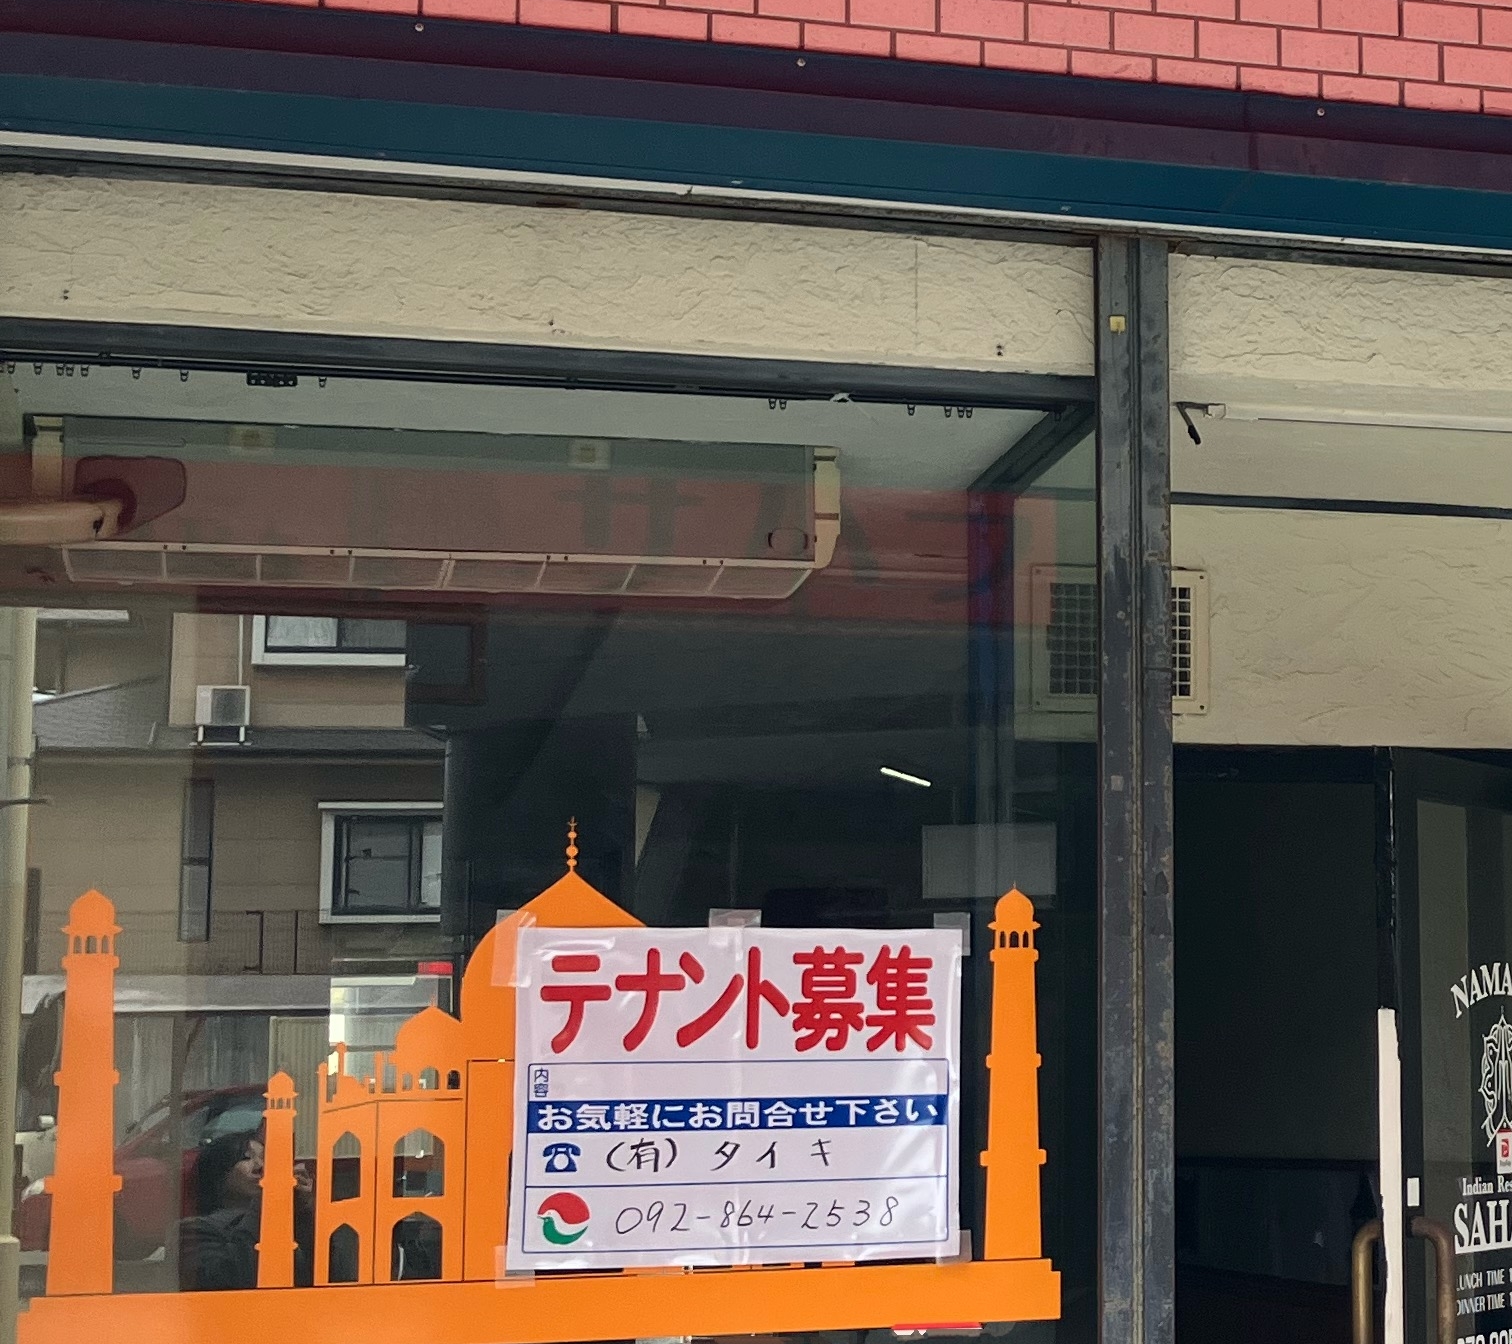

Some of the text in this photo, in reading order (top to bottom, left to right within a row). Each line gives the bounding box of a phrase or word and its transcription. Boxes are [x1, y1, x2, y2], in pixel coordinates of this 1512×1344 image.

[540, 944, 936, 1054] テナント募集
[533, 1067, 550, 1099] 内容
[537, 1097, 939, 1132] お気軽にお問合せ下さい
[1462, 1177, 1494, 1197] Indian
[614, 1195, 900, 1236] 092-864-2538
[1457, 1271, 1483, 1292] UNCH
[1486, 1268, 1506, 1286] TIME
[1486, 1293, 1506, 1310] TIME
